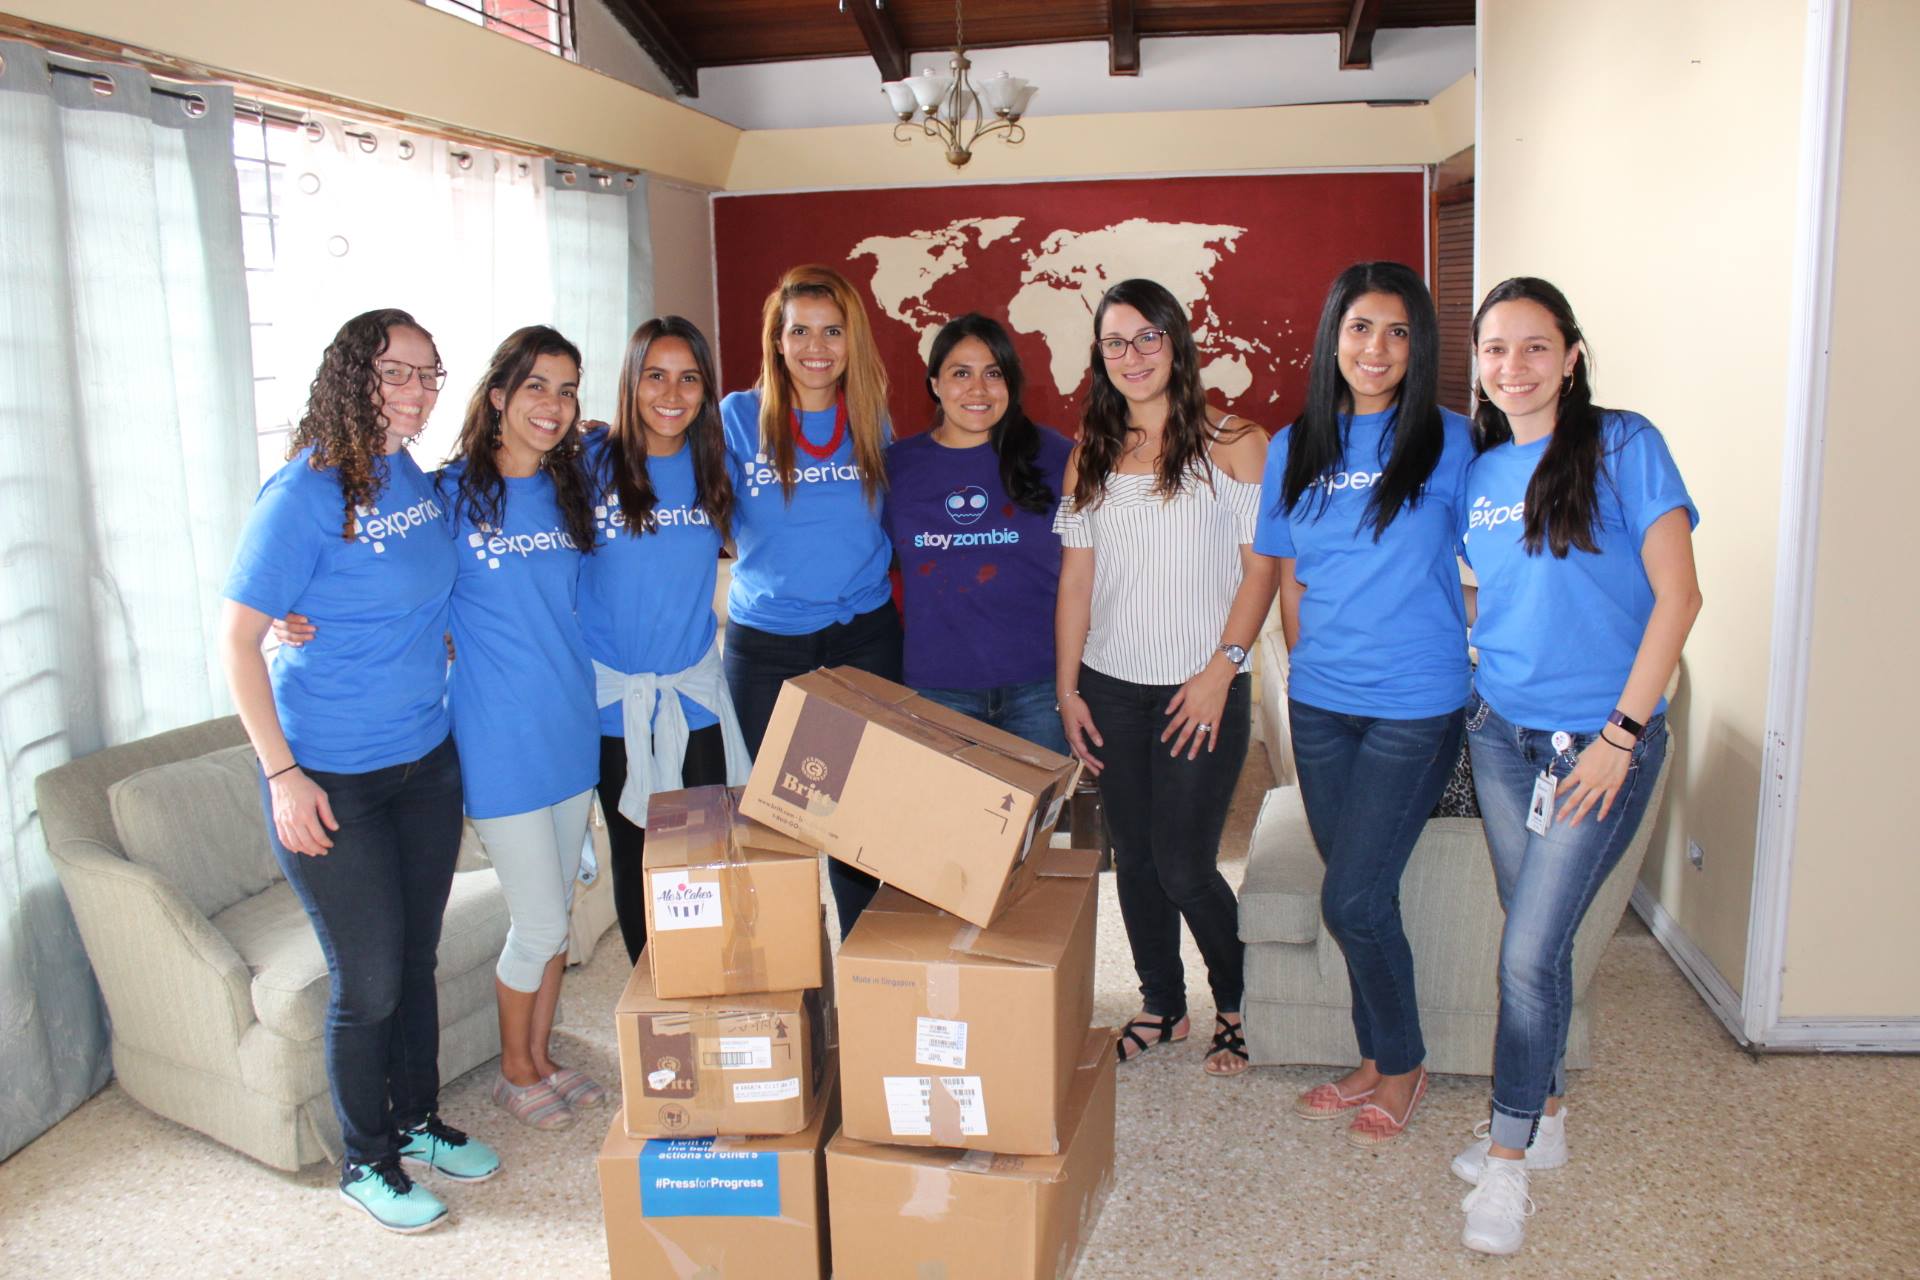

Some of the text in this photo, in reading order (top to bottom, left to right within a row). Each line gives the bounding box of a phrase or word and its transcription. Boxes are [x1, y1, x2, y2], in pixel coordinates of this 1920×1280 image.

[366, 497, 442, 539] experia
[1469, 502, 1525, 531] expe
[488, 526, 578, 558] experia
[655, 1177, 764, 1190] #PressforProgress
